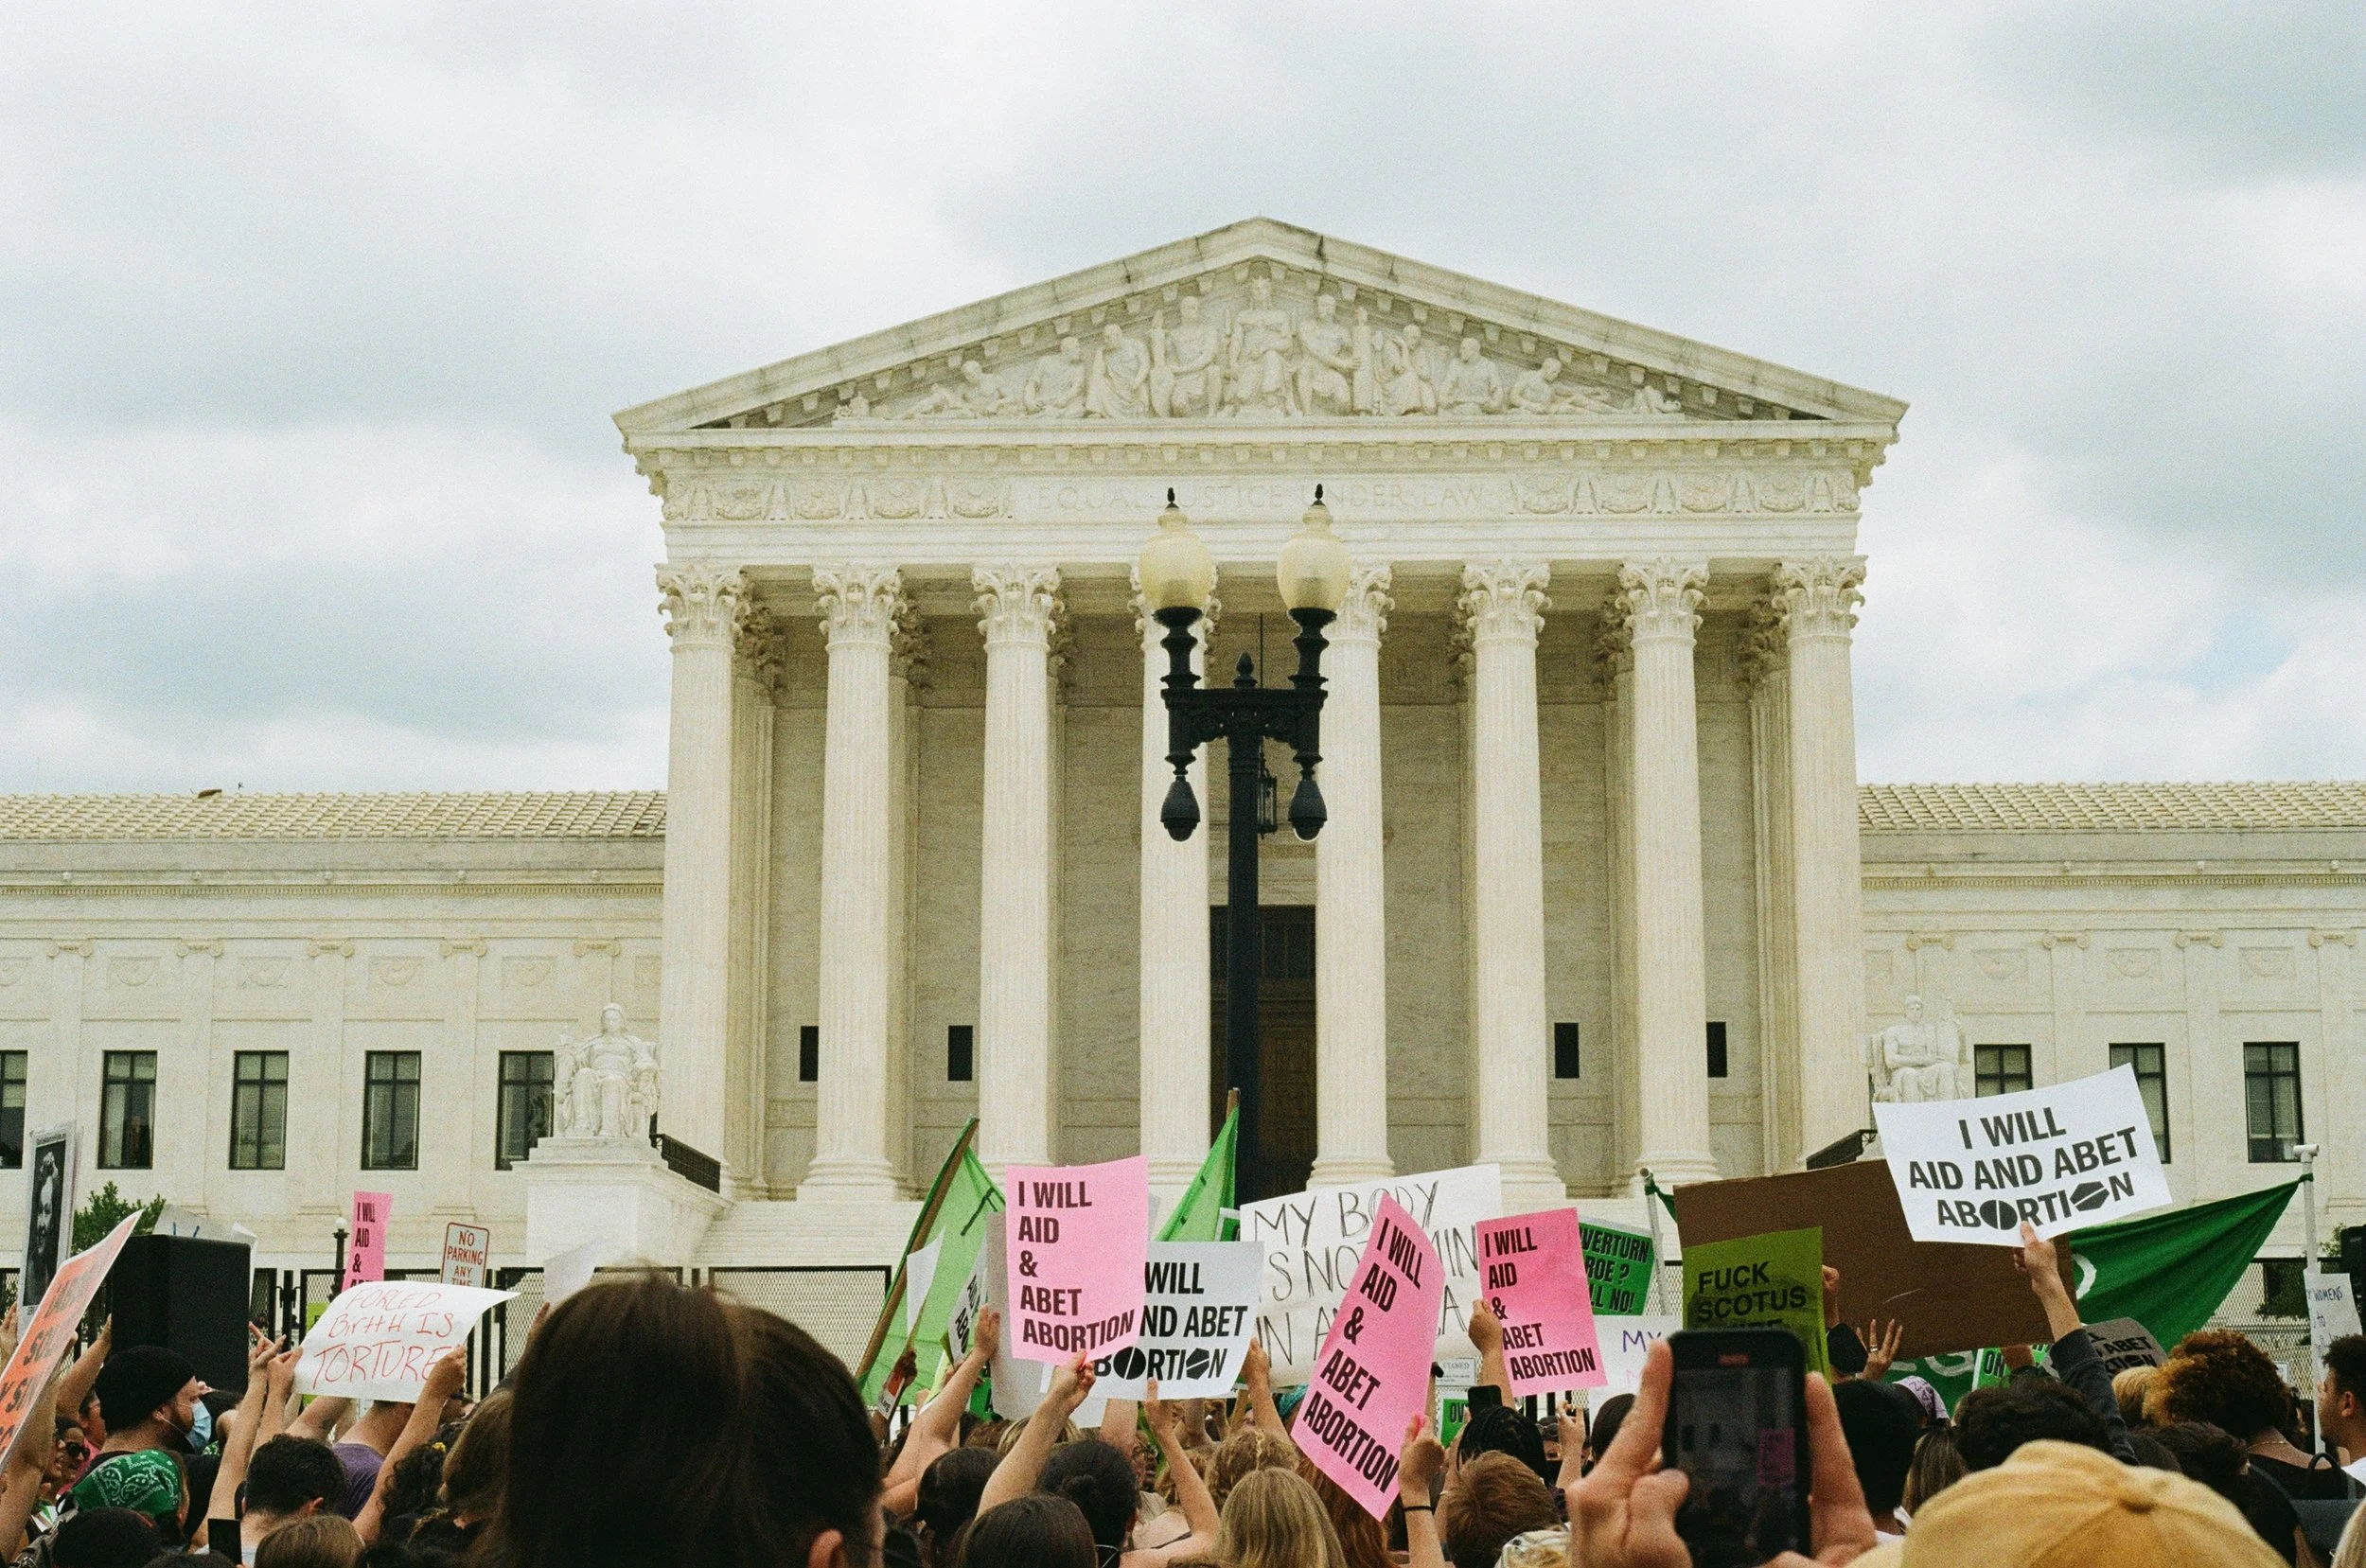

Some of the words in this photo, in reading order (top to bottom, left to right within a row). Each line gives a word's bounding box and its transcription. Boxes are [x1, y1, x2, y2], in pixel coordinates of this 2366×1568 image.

[1421, 484, 1484, 508] LAW
[1958, 1119, 1973, 1150] I
[1980, 1106, 2067, 1148] WILL
[1909, 1160, 1964, 1190] AID
[1974, 1154, 2044, 1190] AND
[2054, 1125, 2138, 1180] ABET
[1018, 1180, 1025, 1207] I
[1033, 1180, 1093, 1208] WILL
[357, 1202, 362, 1222] I
[362, 1204, 376, 1224] WILL
[1017, 1215, 1060, 1243] AID
[1254, 1195, 1317, 1248] MY
[355, 1227, 370, 1248] AID
[458, 1230, 475, 1246] NO
[1376, 1217, 1390, 1252] I
[1387, 1224, 1422, 1290] WILL
[1485, 1233, 1491, 1258] I
[1493, 1226, 1538, 1256] WILL
[1581, 1227, 1650, 1264] VERTURN
[352, 1253, 362, 1273] &
[447, 1245, 484, 1265] PARKING
[453, 1265, 473, 1277] ANY
[1018, 1250, 1039, 1277] &
[1144, 1261, 1205, 1295] WILL
[1359, 1262, 1398, 1313] AID
[1489, 1261, 1518, 1290] AID
[1698, 1260, 1770, 1295] FUCK
[344, 1287, 442, 1312] FORCED
[1020, 1284, 1083, 1316] ABET
[1492, 1296, 1509, 1320] &
[1609, 1287, 1636, 1314] NO!
[1696, 1285, 1808, 1324] SCOTUS
[415, 1312, 454, 1338] IS
[1022, 1308, 1136, 1353] ABORTION
[1139, 1305, 1178, 1338] ND
[1183, 1305, 1248, 1338] ABET
[1344, 1305, 1365, 1346] &
[1502, 1322, 1545, 1350] ABET
[2103, 1335, 2153, 1354] ABET
[1094, 1346, 1228, 1381] BORTION
[1510, 1347, 1597, 1381] ABORTION
[1319, 1348, 1381, 1412] ABET
[1302, 1390, 1400, 1494] ABORTION
